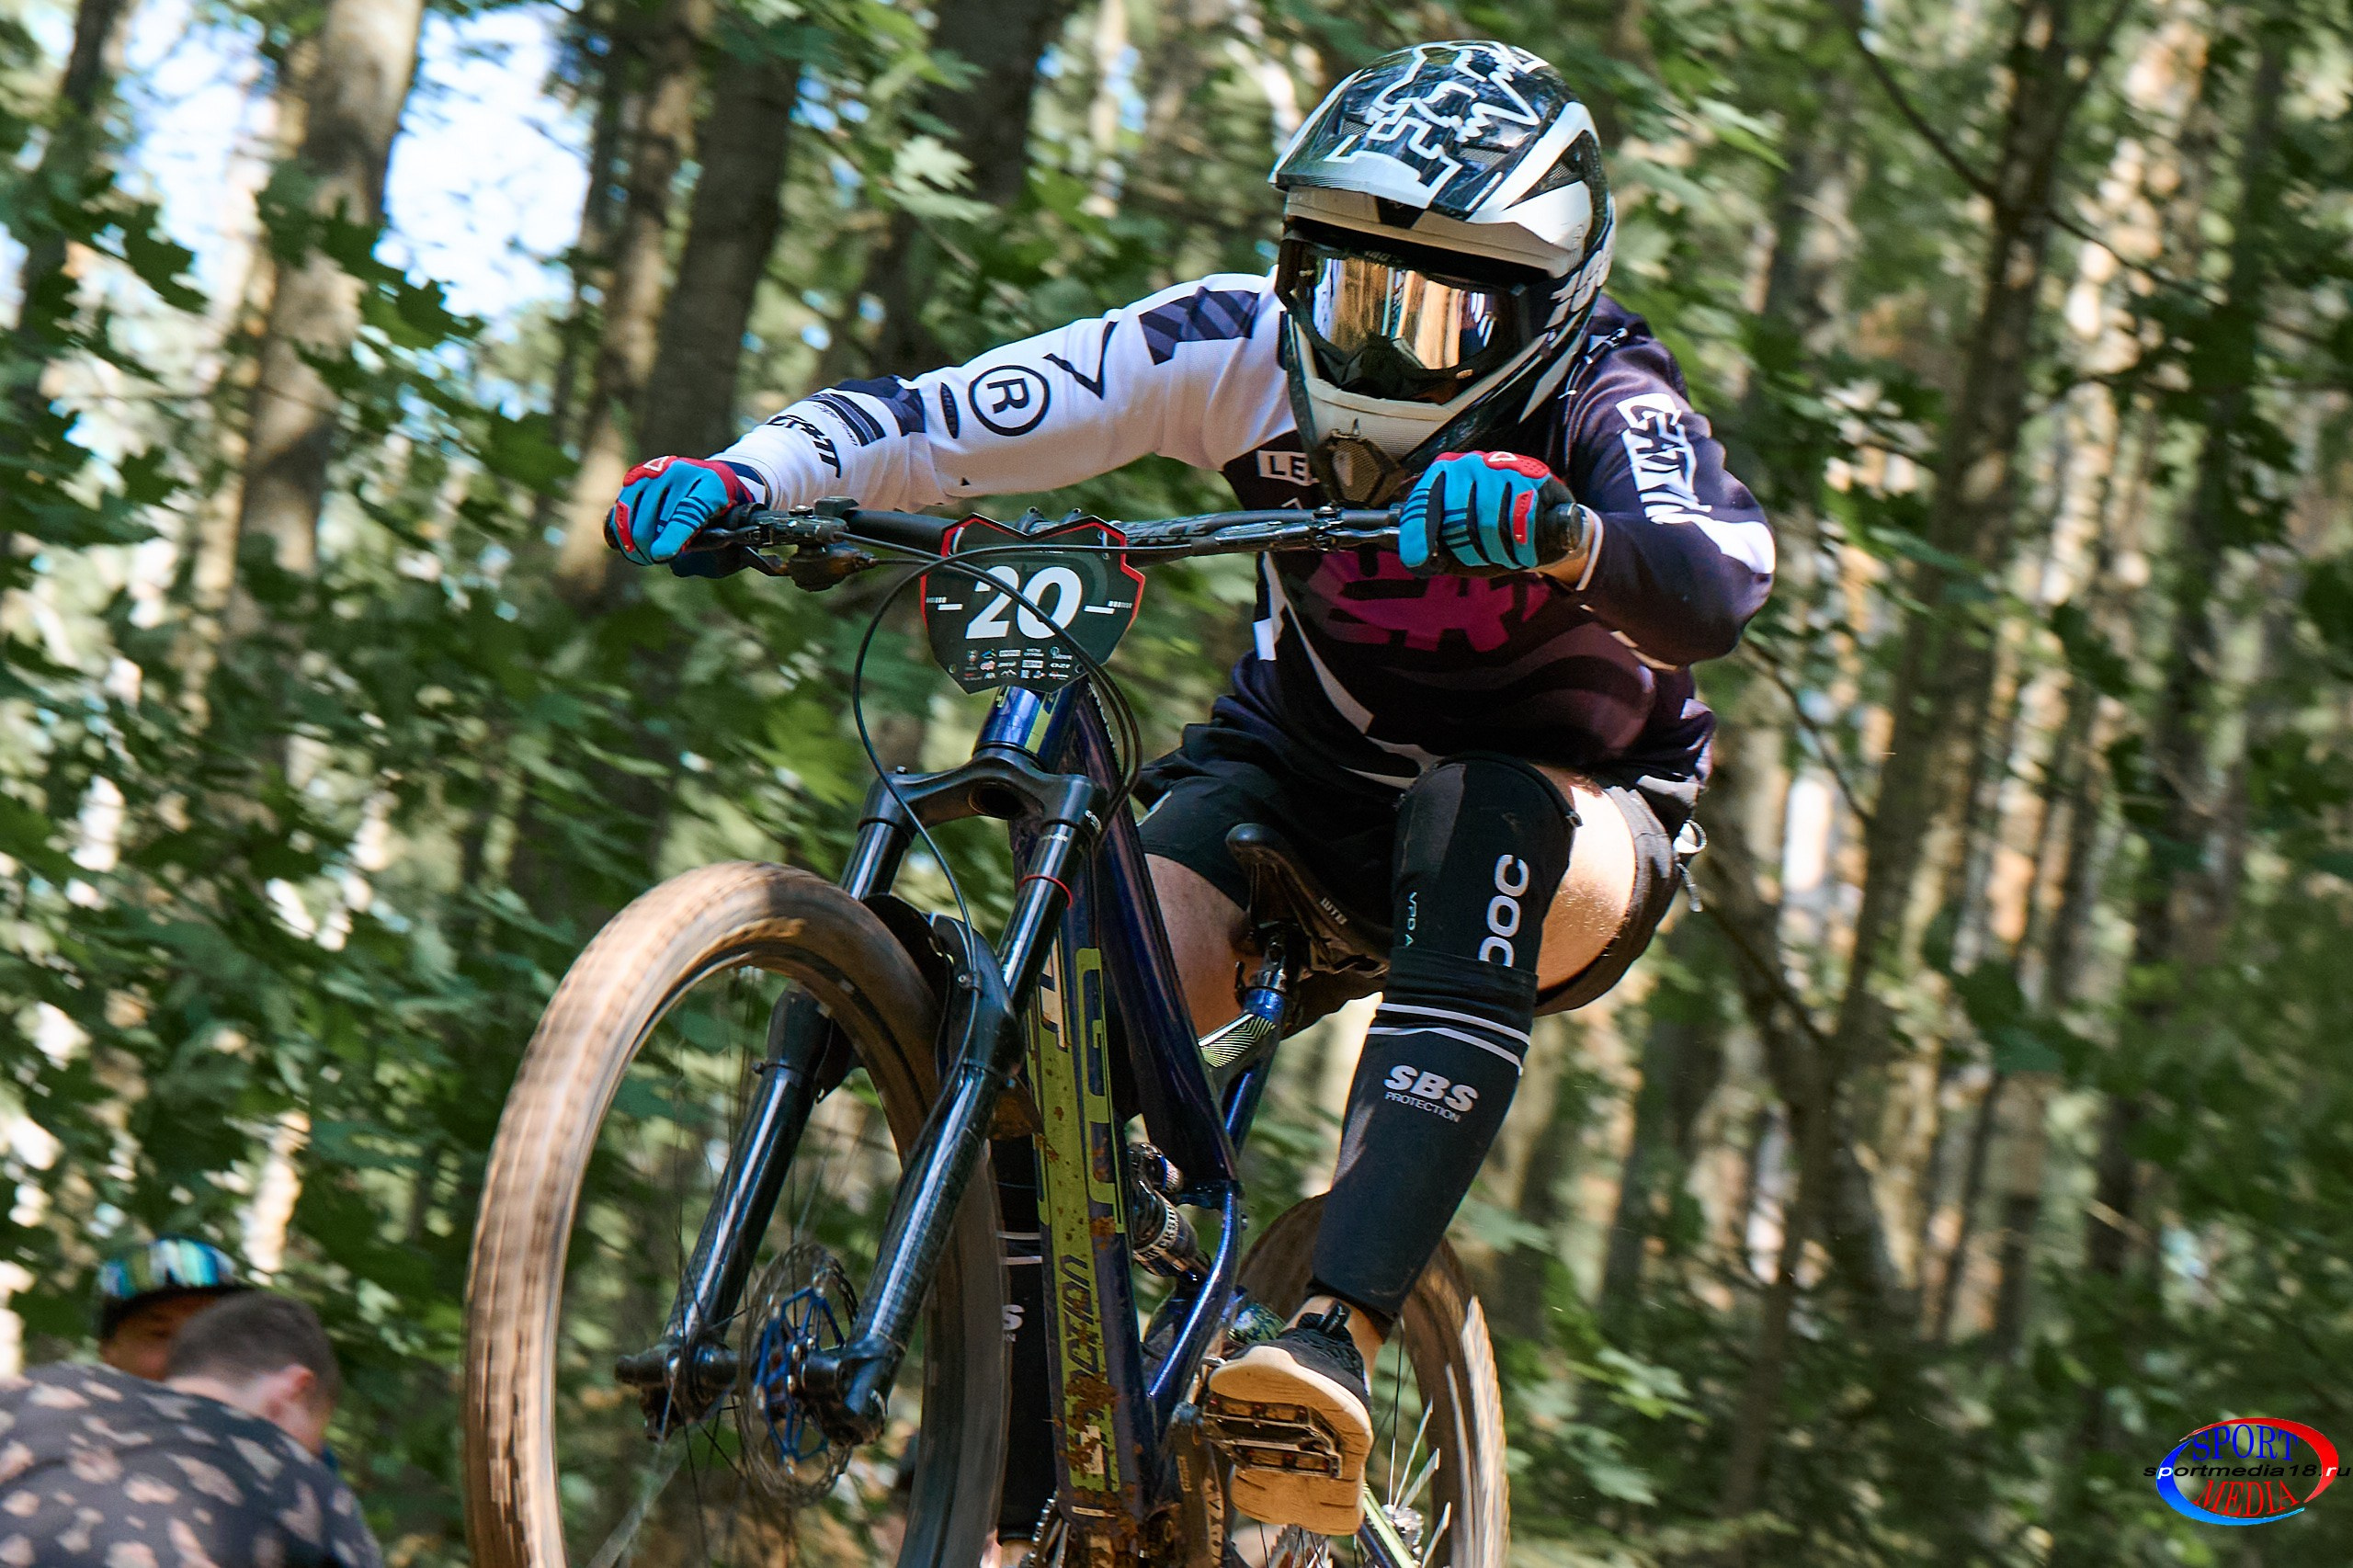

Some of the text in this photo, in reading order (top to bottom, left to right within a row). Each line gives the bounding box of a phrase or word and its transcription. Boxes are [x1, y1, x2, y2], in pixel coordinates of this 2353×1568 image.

[965, 564, 1083, 640] 20
[1384, 1064, 1478, 1112] SBS
[1385, 1090, 1461, 1123] PROTECTION
